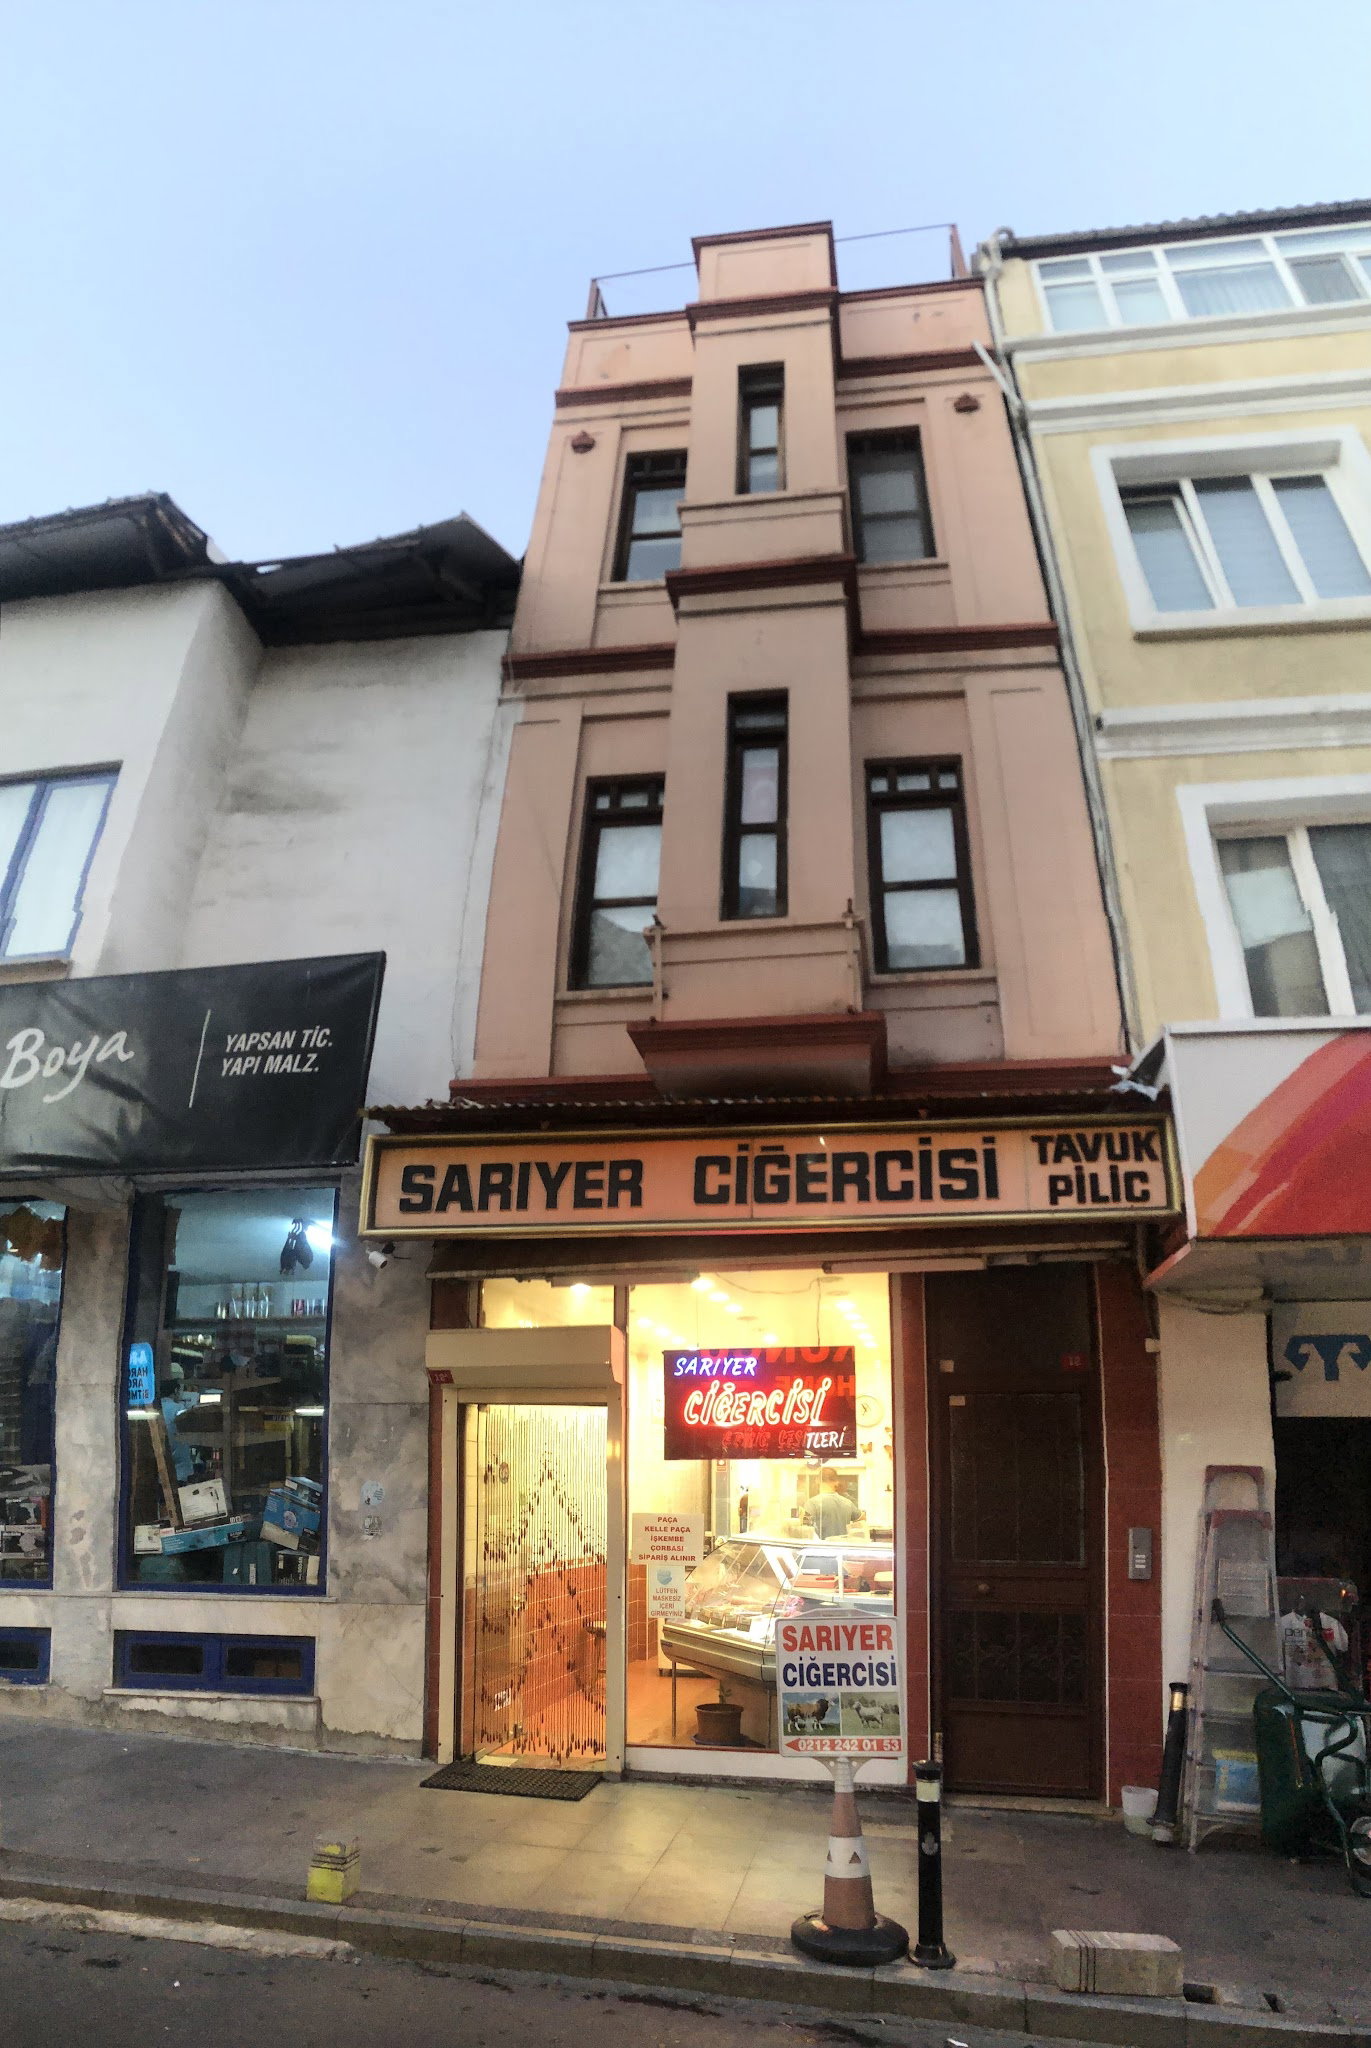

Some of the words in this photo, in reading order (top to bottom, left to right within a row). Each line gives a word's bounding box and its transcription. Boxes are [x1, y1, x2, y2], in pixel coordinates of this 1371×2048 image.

[225, 1029, 295, 1053] YAPSAN
[301, 1025, 333, 1048] TİC.
[0, 1028, 135, 1103] Boya
[221, 1057, 260, 1077] YAPI
[263, 1053, 320, 1074] MALZ.
[1031, 1130, 1160, 1165] TAVUK
[399, 1158, 643, 1214] SARIYER
[694, 1136, 1000, 1206] CİĞERCİSİ
[673, 1356, 758, 1377] SARIYER
[684, 1377, 832, 1427] CİĞERCİSİ
[657, 1516, 678, 1525] PAÇA
[670, 1526, 691, 1534] PAÇA
[650, 1535, 685, 1543] İŞKEMBE
[638, 1553, 669, 1562] SİPARİŞ
[652, 1594, 681, 1602] MASKESİZ
[660, 1602, 675, 1610] İÇERİ
[650, 1609, 683, 1617] GİRMEYİNİZ
[782, 1624, 893, 1652] SARIYER
[782, 1655, 897, 1687] CİĞERCİSİ
[797, 1739, 830, 1751] 0212
[834, 1739, 860, 1751] 242
[862, 1739, 877, 1751] 01
[883, 1739, 900, 1751] 53
